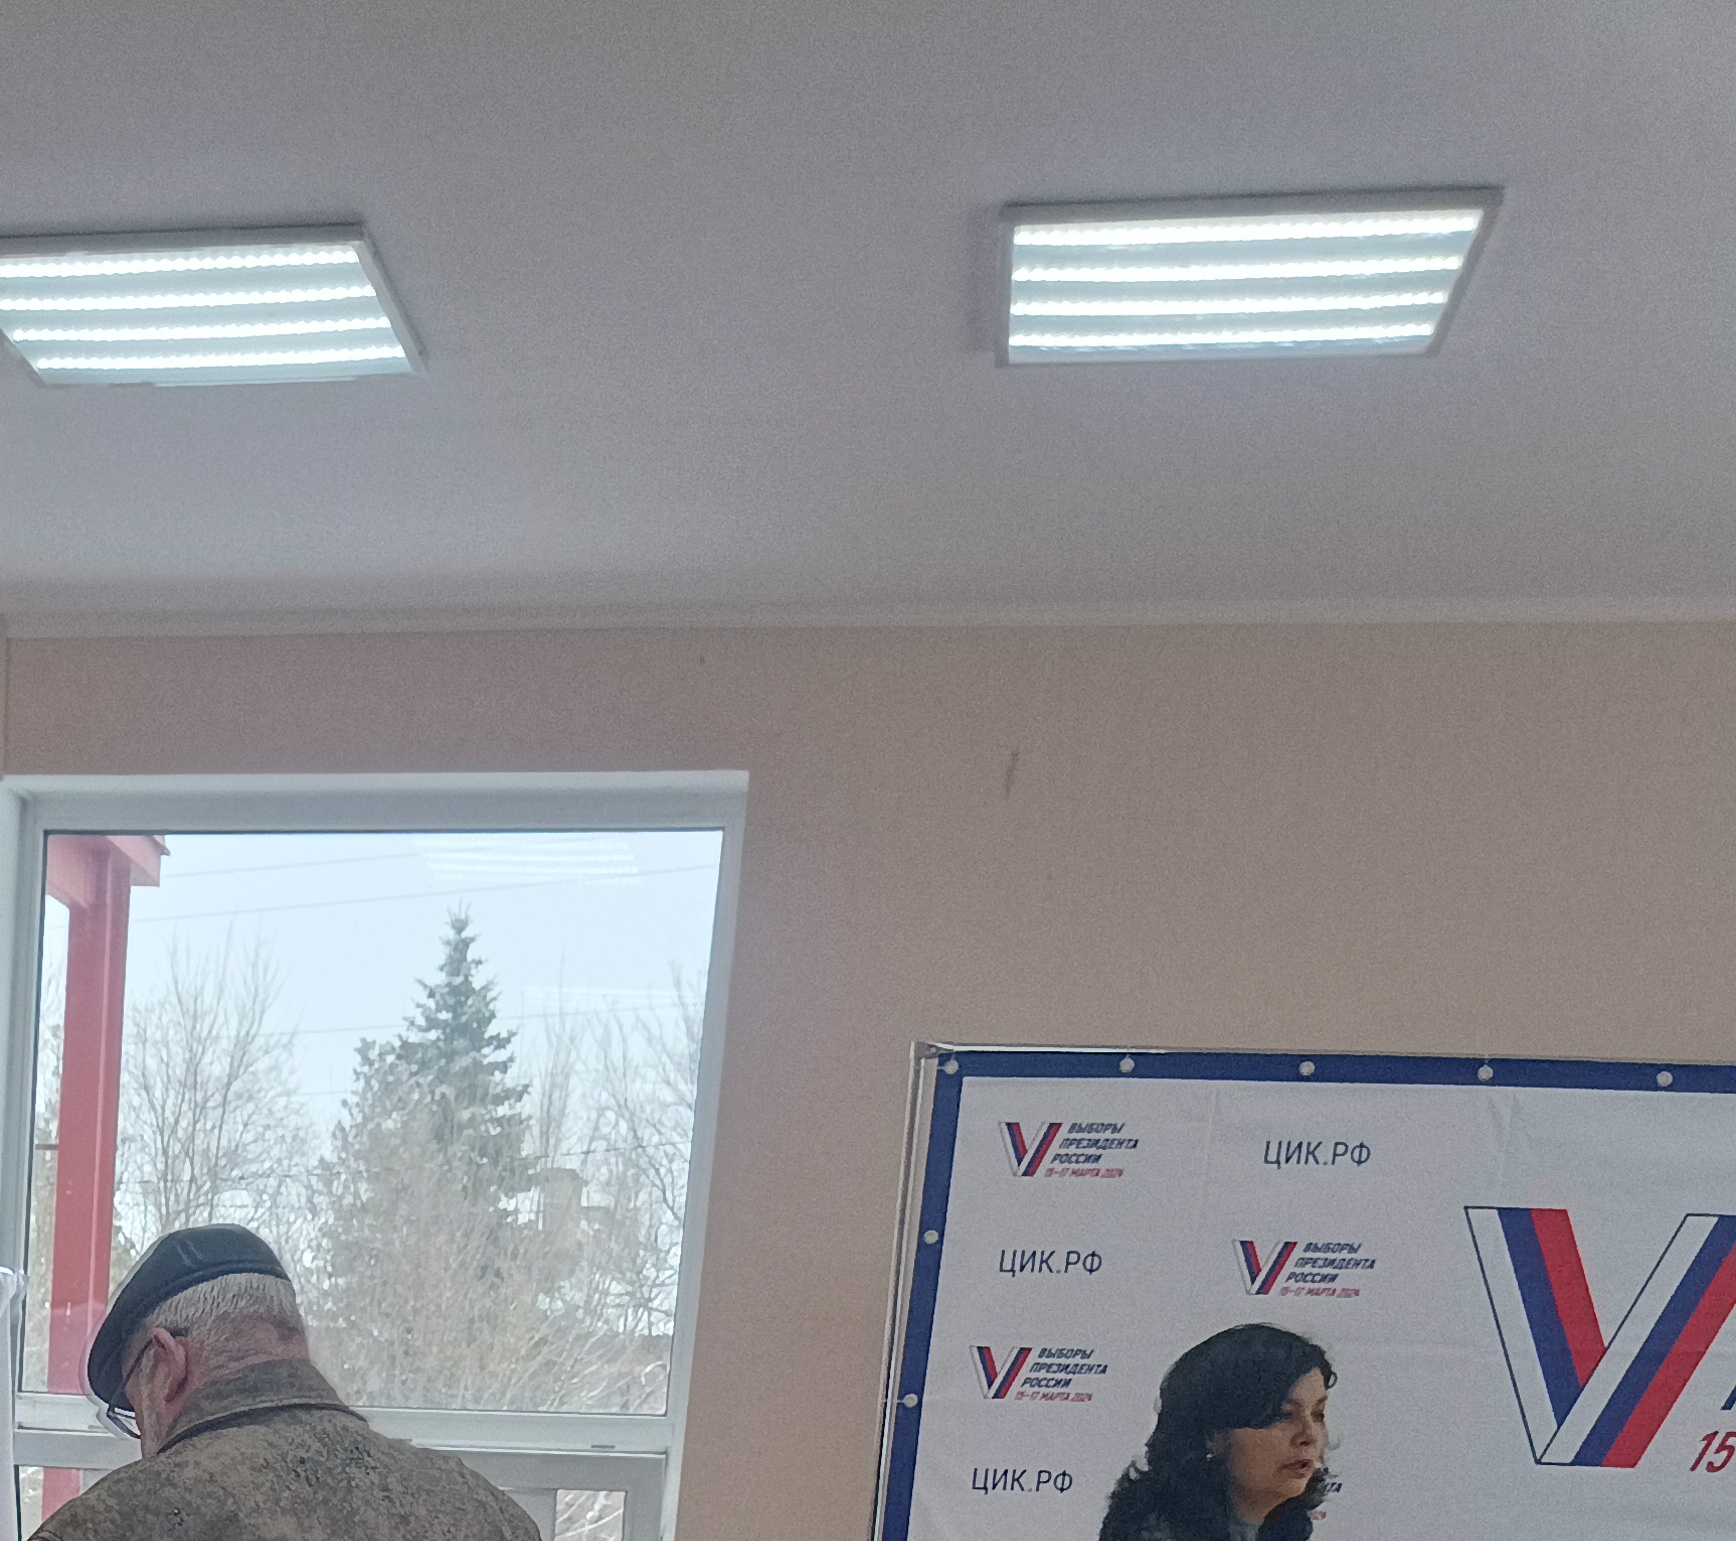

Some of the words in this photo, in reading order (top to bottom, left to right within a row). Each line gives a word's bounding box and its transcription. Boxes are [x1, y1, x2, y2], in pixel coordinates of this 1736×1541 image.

[1067, 1122, 1125, 1134] ВЫБОРЫ
[1059, 1138, 1139, 1150] ПРЕЗИДЕНТА
[1050, 1153, 1102, 1164] РОССИИ
[1263, 1140, 1371, 1170] ЦИК.РФ
[1303, 1242, 1362, 1254] ВЫБОРЫ
[999, 1249, 1102, 1278] ЦИК.РФ
[1294, 1257, 1376, 1270] ПРЕЗИДЕНТА
[1285, 1272, 1339, 1283] РОССИИ
[1038, 1348, 1094, 1359] ВЫБОРЫ
[1029, 1362, 1108, 1375] ПРЕЗИДЕНТА
[1020, 1377, 1072, 1388] РОССИИ
[972, 1468, 1073, 1495] ЦИК.РФ
